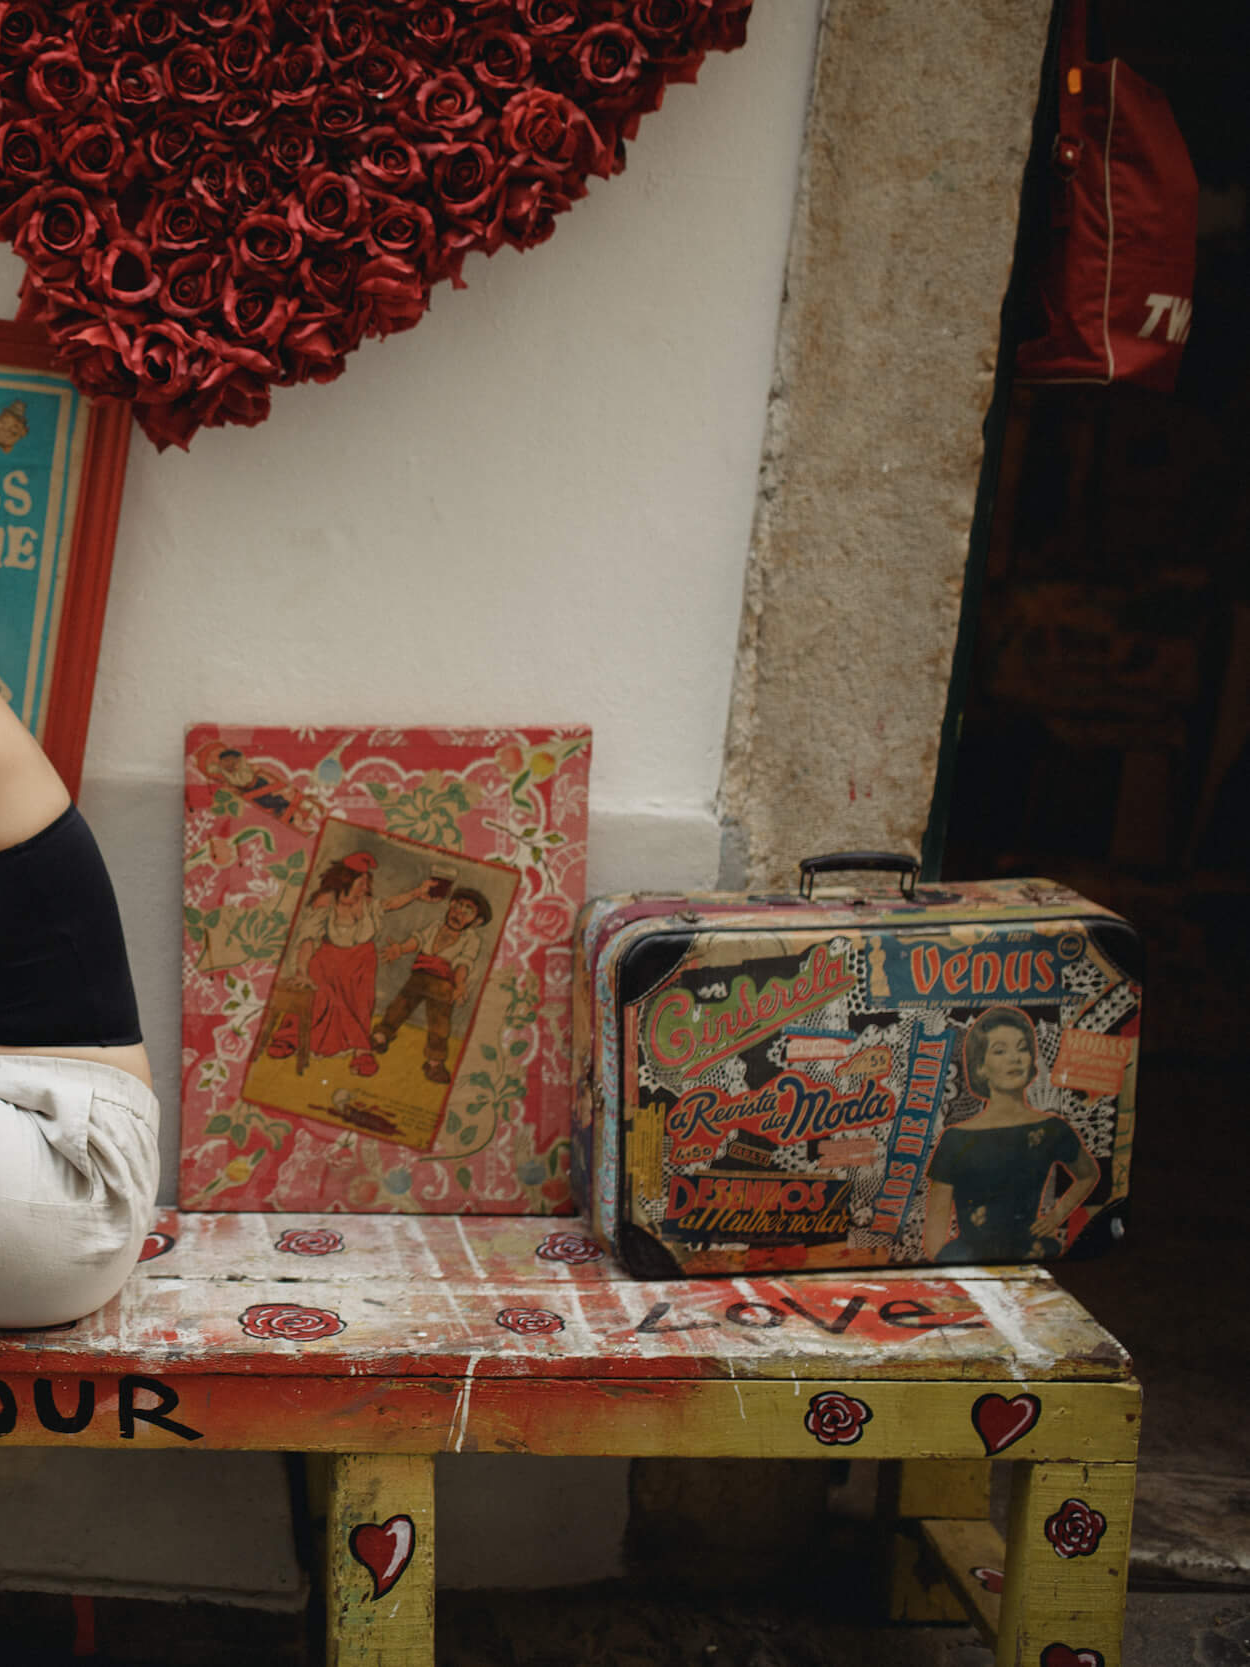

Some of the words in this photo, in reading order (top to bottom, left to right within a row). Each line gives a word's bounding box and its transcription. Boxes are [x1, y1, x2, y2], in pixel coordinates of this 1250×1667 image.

[910, 944, 1054, 994] Vénus
[650, 947, 855, 1067] Cinderela
[904, 1039, 947, 1111] FADA
[683, 1090, 777, 1139] Revista
[761, 1112, 787, 1132] da
[777, 1076, 889, 1140] Moda
[895, 1115, 929, 1156] DE
[666, 1176, 827, 1219] DESENHOS
